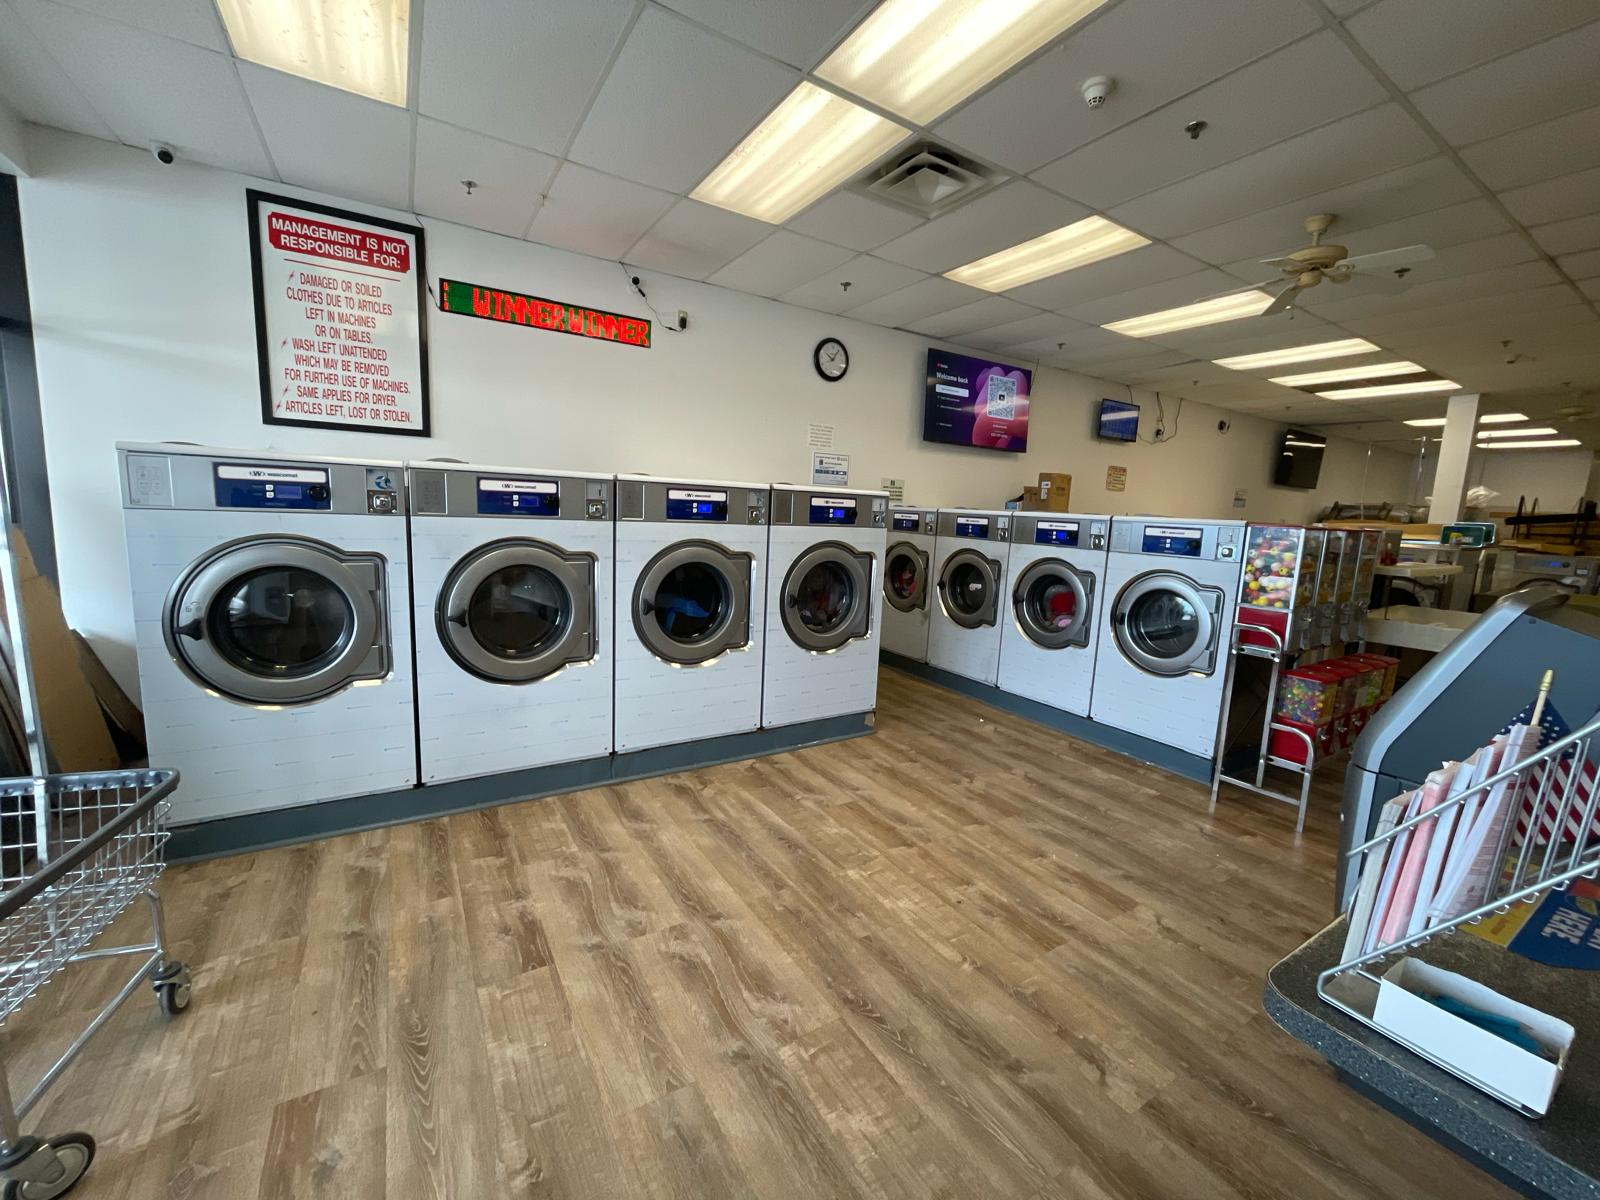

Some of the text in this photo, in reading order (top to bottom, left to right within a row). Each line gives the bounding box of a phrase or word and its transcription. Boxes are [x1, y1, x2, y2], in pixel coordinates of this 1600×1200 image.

[272, 218, 406, 255] MANAGEMENT IS NOT
[281, 236, 400, 268] RESPONSIBLE FOR:
[300, 273, 381, 297] DAMAGED OR SOILED
[287, 288, 392, 316] CLOTHES DUE TO ARTICLES
[305, 309, 376, 328] LEFT IN MACHINES
[472, 287, 565, 331] WINNER
[568, 308, 648, 346] WINNER
[315, 325, 373, 344] OR ON TABLES.
[292, 339, 387, 361] WASH LEFT UNATTENDED
[295, 356, 389, 376] WHICH MAY BE REMOVED
[936, 372, 956, 381] Welcome
[285, 368, 410, 394] FOR FURTHER USE OF MACHINES.
[297, 386, 397, 406] SAME APPLIES FOR DRYER.
[285, 401, 412, 423] ARTICLES LEFT, LOST OR STOLEN.
[1540, 907, 1592, 944] HERE
